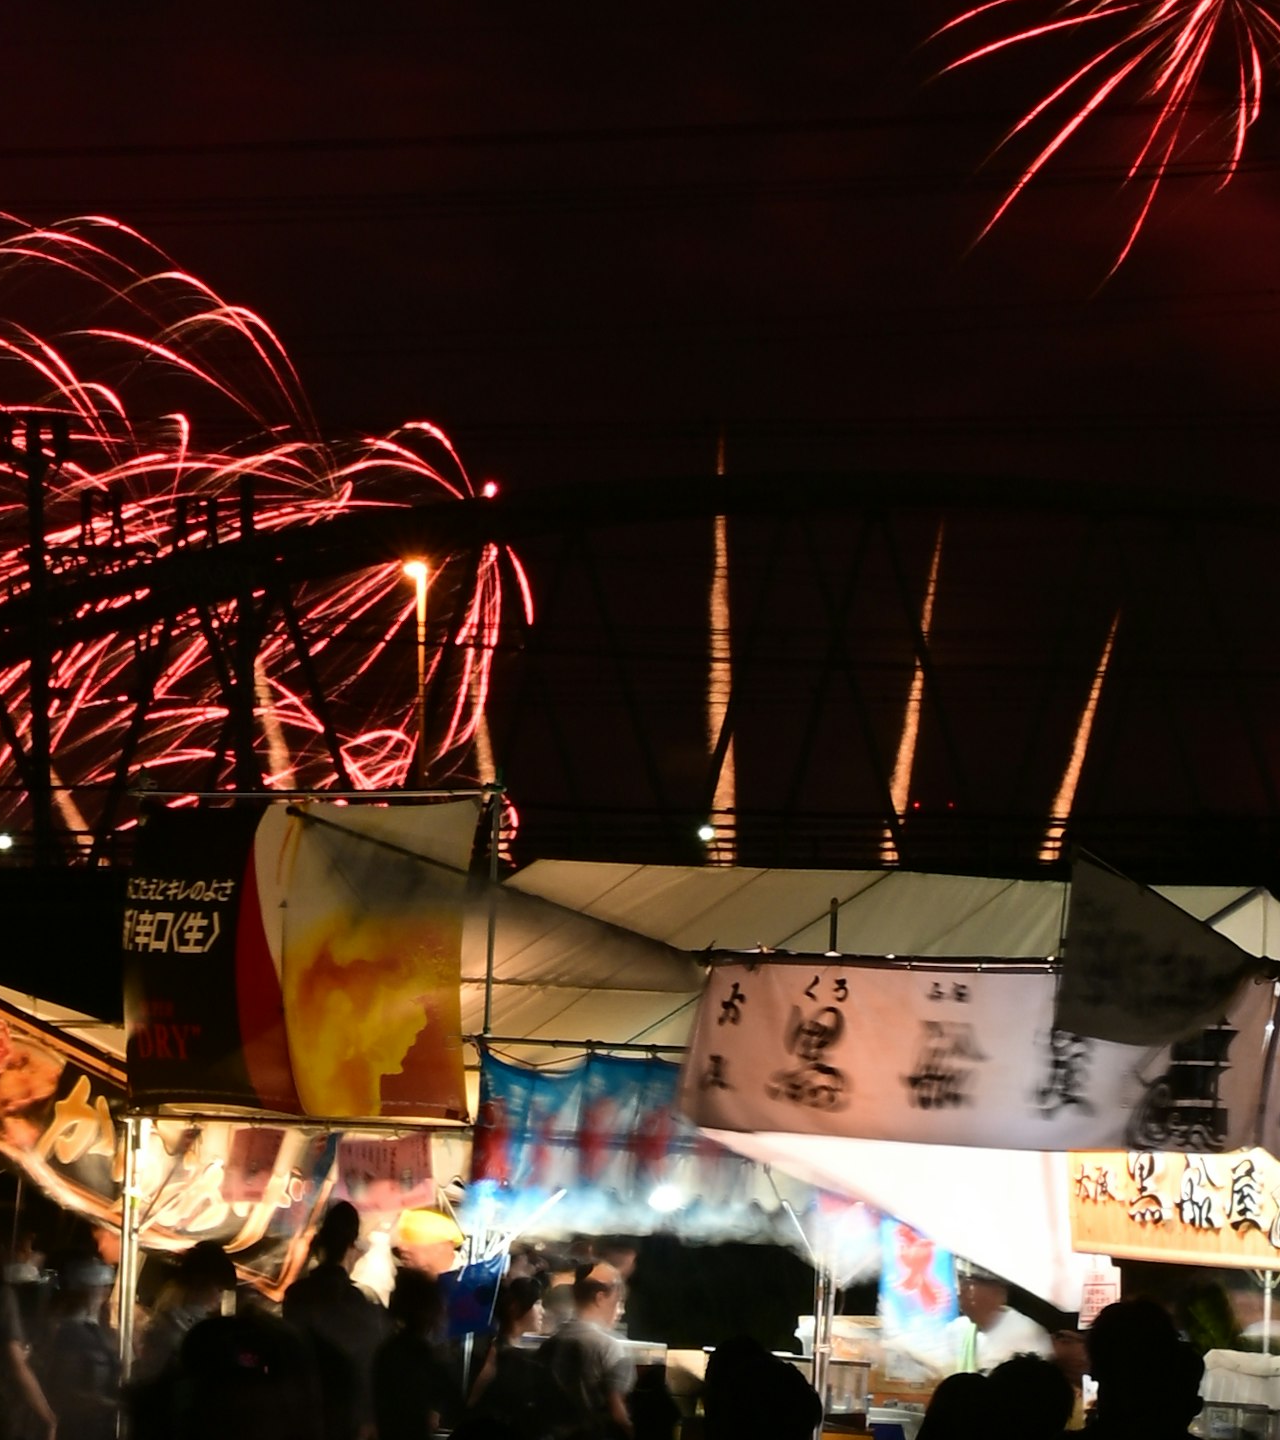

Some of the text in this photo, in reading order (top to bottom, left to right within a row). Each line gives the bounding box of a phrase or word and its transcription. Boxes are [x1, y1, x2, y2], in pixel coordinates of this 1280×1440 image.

[127, 877, 236, 902] ごたえとキレのよさ
